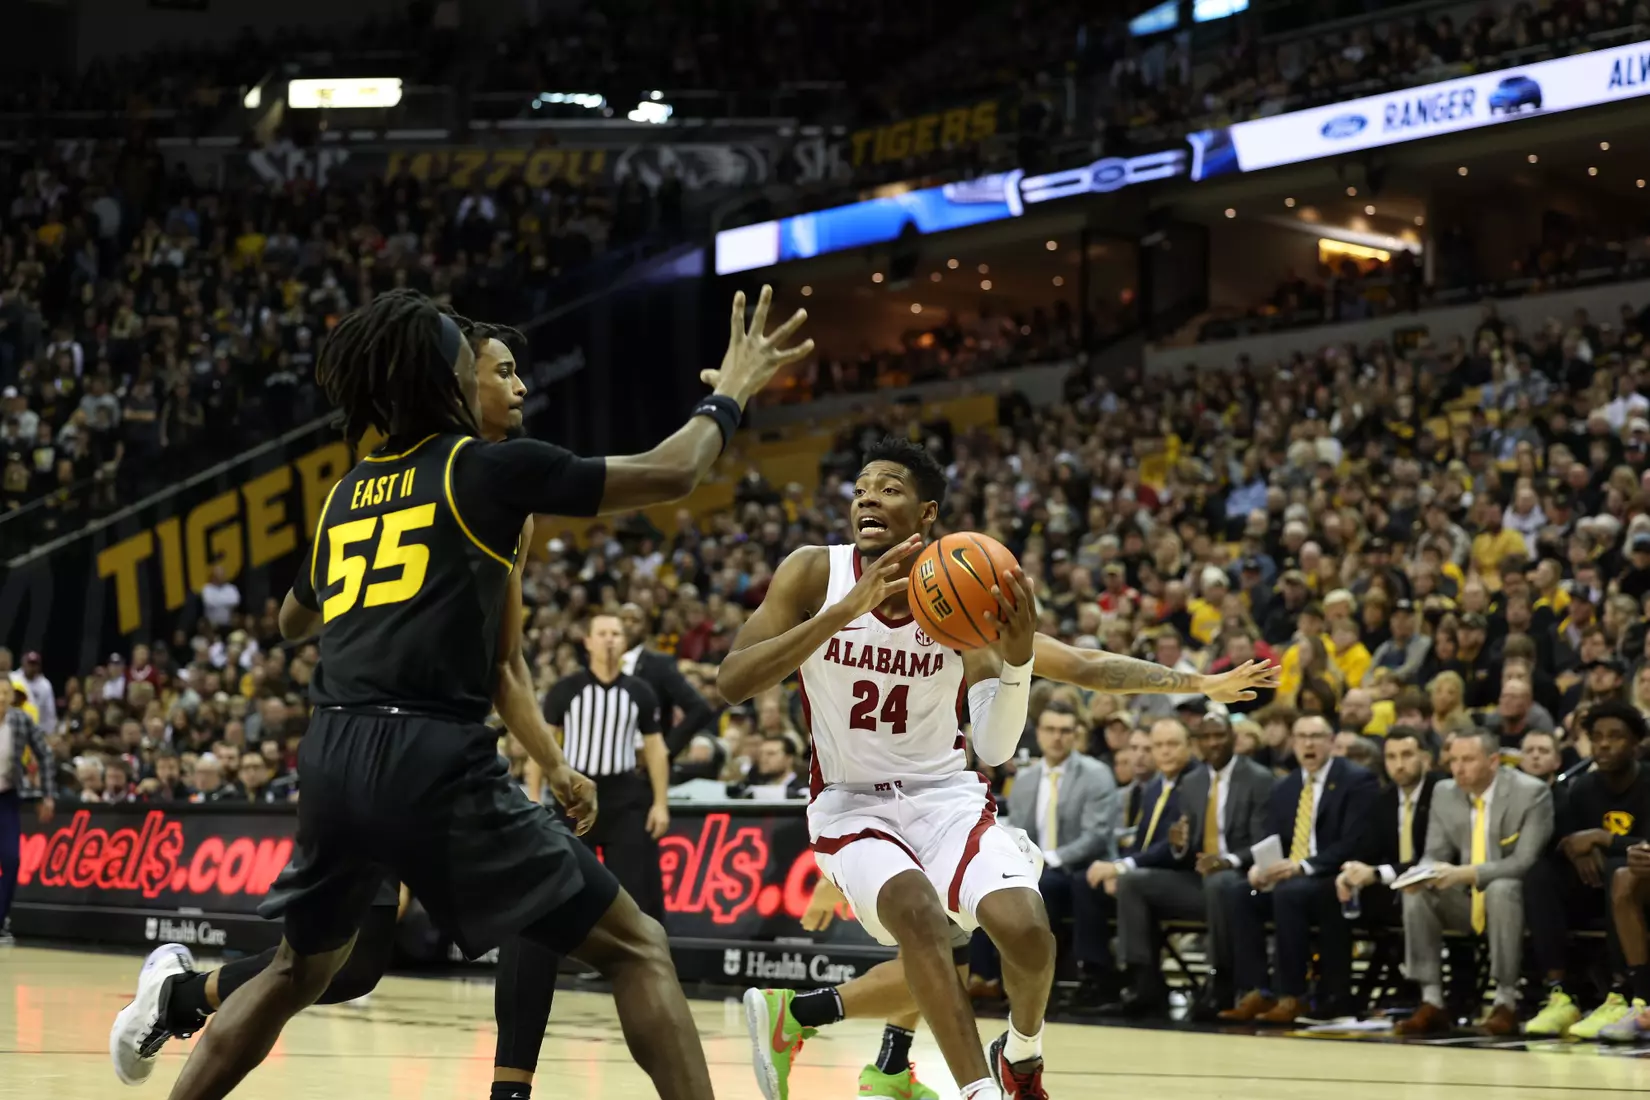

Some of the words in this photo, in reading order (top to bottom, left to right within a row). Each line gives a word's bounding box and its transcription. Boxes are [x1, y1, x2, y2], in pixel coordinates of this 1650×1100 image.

[850, 102, 999, 167] TIGERS
[1384, 88, 1476, 132] RANGER
[350, 473, 400, 510] EAST
[97, 424, 388, 634] TIGER
[323, 502, 437, 624] 55
[919, 557, 954, 622] ELITE
[823, 637, 944, 678] ALABAMA
[849, 680, 910, 735] 24
[159, 920, 197, 942] Health
[197, 922, 226, 945] Care
[745, 951, 807, 979] Health
[809, 955, 856, 982] Care
